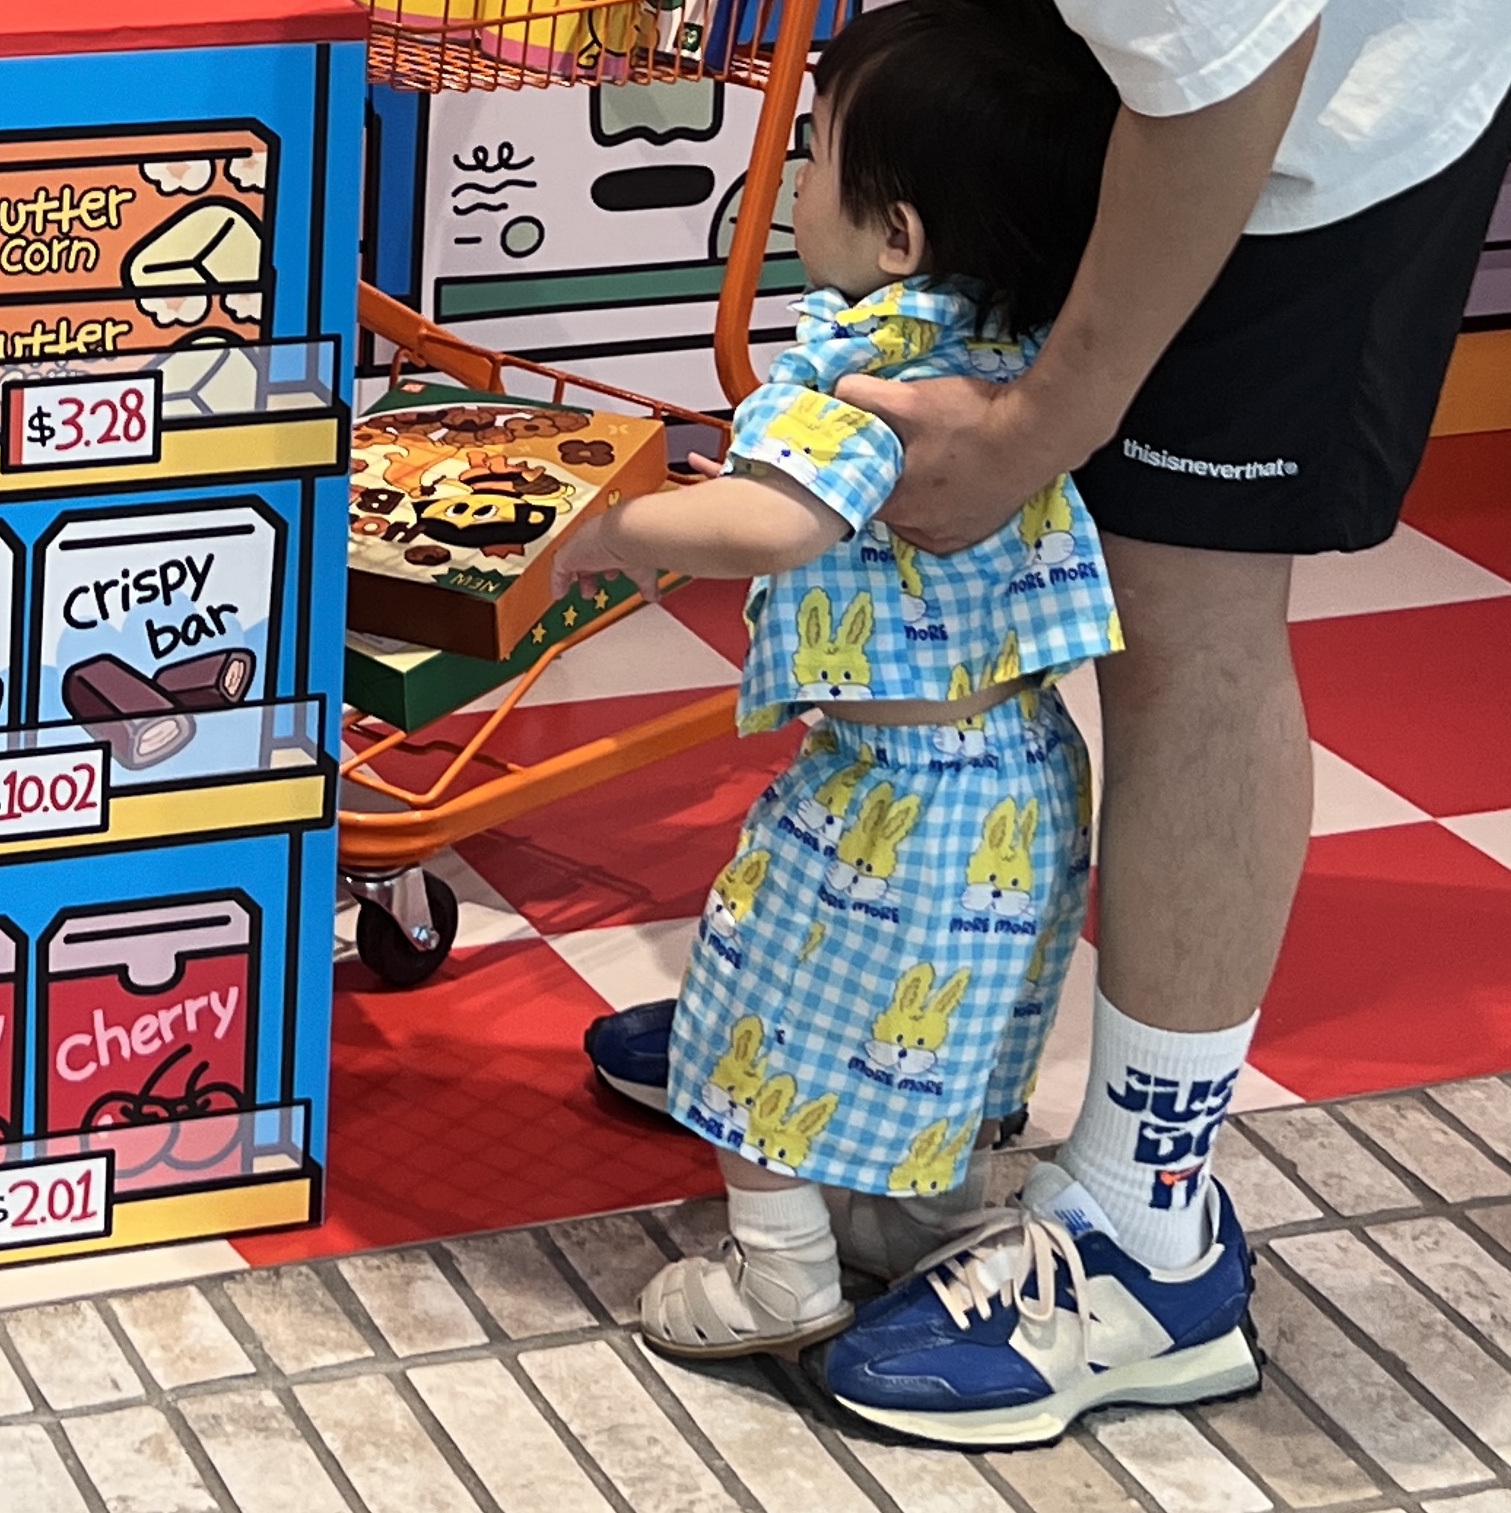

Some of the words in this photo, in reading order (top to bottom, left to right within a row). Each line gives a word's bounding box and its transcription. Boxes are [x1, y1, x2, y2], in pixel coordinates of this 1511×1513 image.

[0, 237, 97, 273] corn
[27, 388, 146, 451] $3.28
[63, 552, 215, 630] crispy
[145, 602, 238, 659] bar
